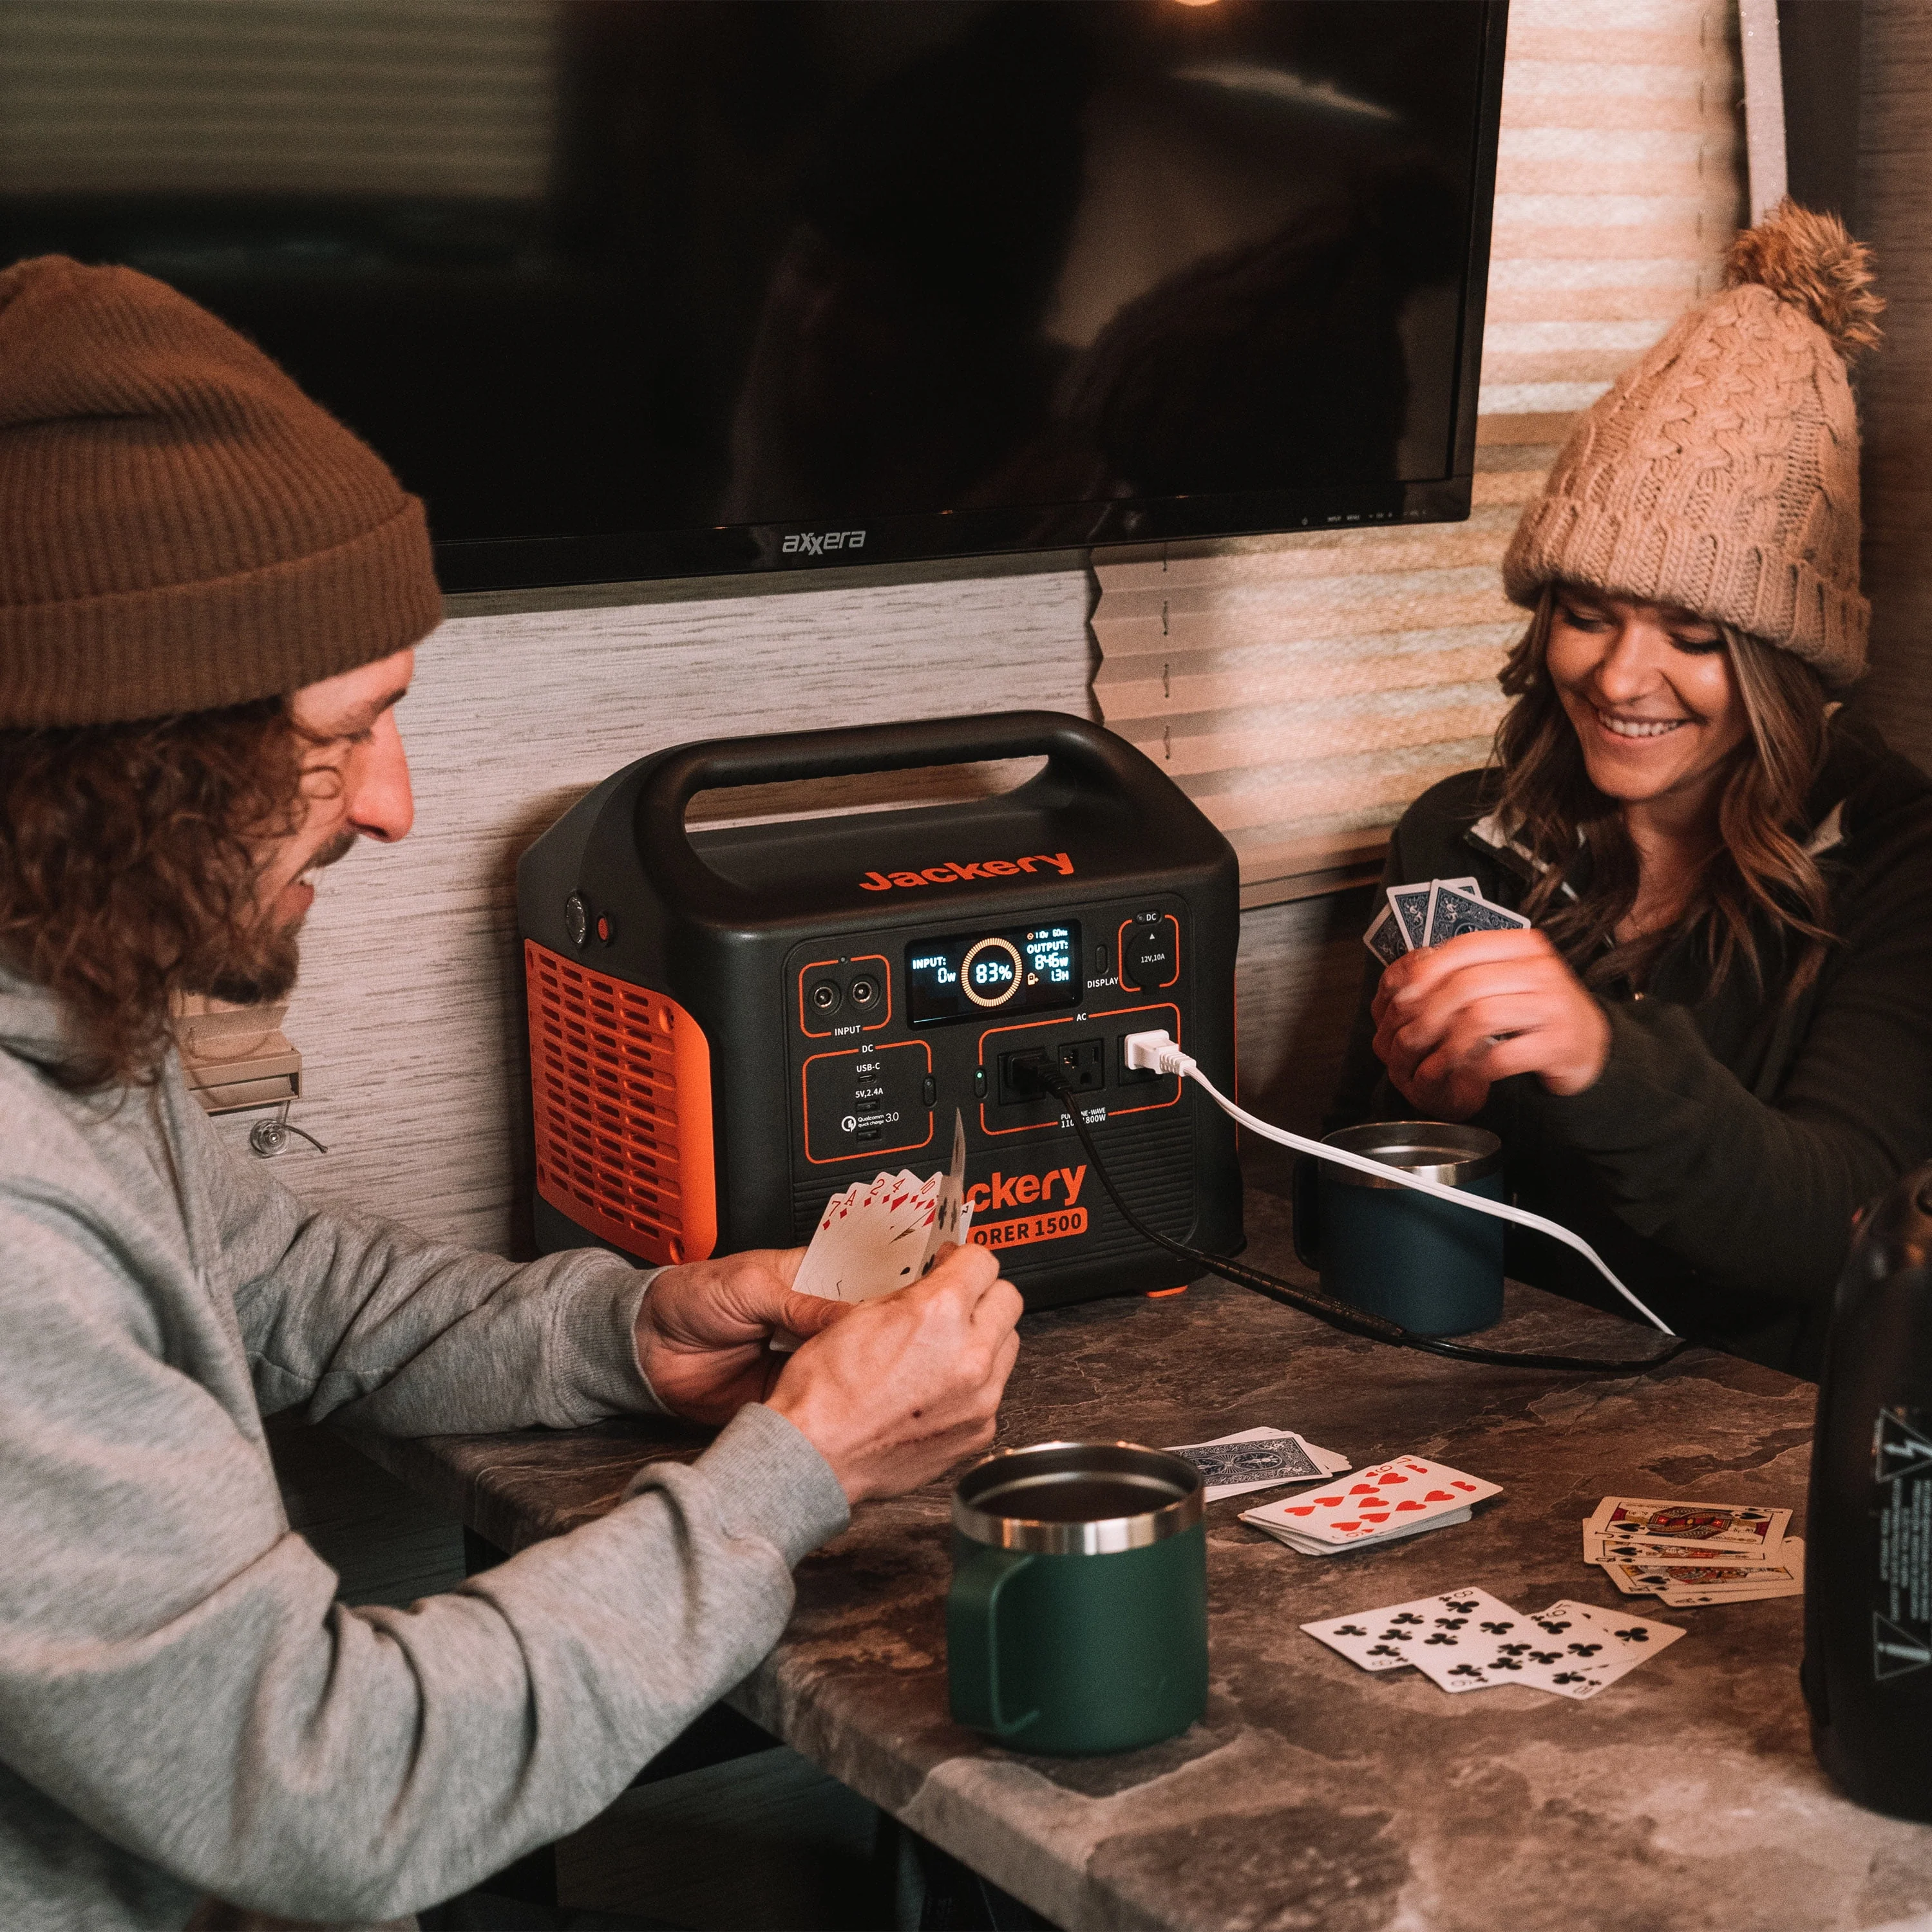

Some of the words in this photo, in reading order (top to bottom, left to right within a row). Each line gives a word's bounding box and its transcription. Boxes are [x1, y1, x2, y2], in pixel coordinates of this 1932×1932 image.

[858, 852, 1074, 891] Jackery
[1146, 913, 1157, 922] DC
[1027, 940, 1068, 954] OUTPUT:
[913, 956, 947, 970] INPUT:
[1141, 953, 1166, 963] 12V,10A
[976, 962, 1013, 983] 83%
[1087, 977, 1119, 989] DISPLAY
[1076, 1013, 1087, 1022] AC
[834, 1025, 861, 1036] INPUT
[862, 1044, 874, 1053] DC
[856, 1063, 881, 1073] USB-C
[855, 1087, 884, 1099] 5V,2.4A
[858, 1114, 885, 1122] Qualcomm
[885, 1112, 900, 1122] 3.0
[869, 1179, 886, 1196] 2
[961, 1164, 1088, 1213] ckery
[844, 1189, 857, 1206] A
[828, 1200, 841, 1217] 7
[974, 1222, 1030, 1246] ORER
[1035, 1213, 1082, 1236] 1500
